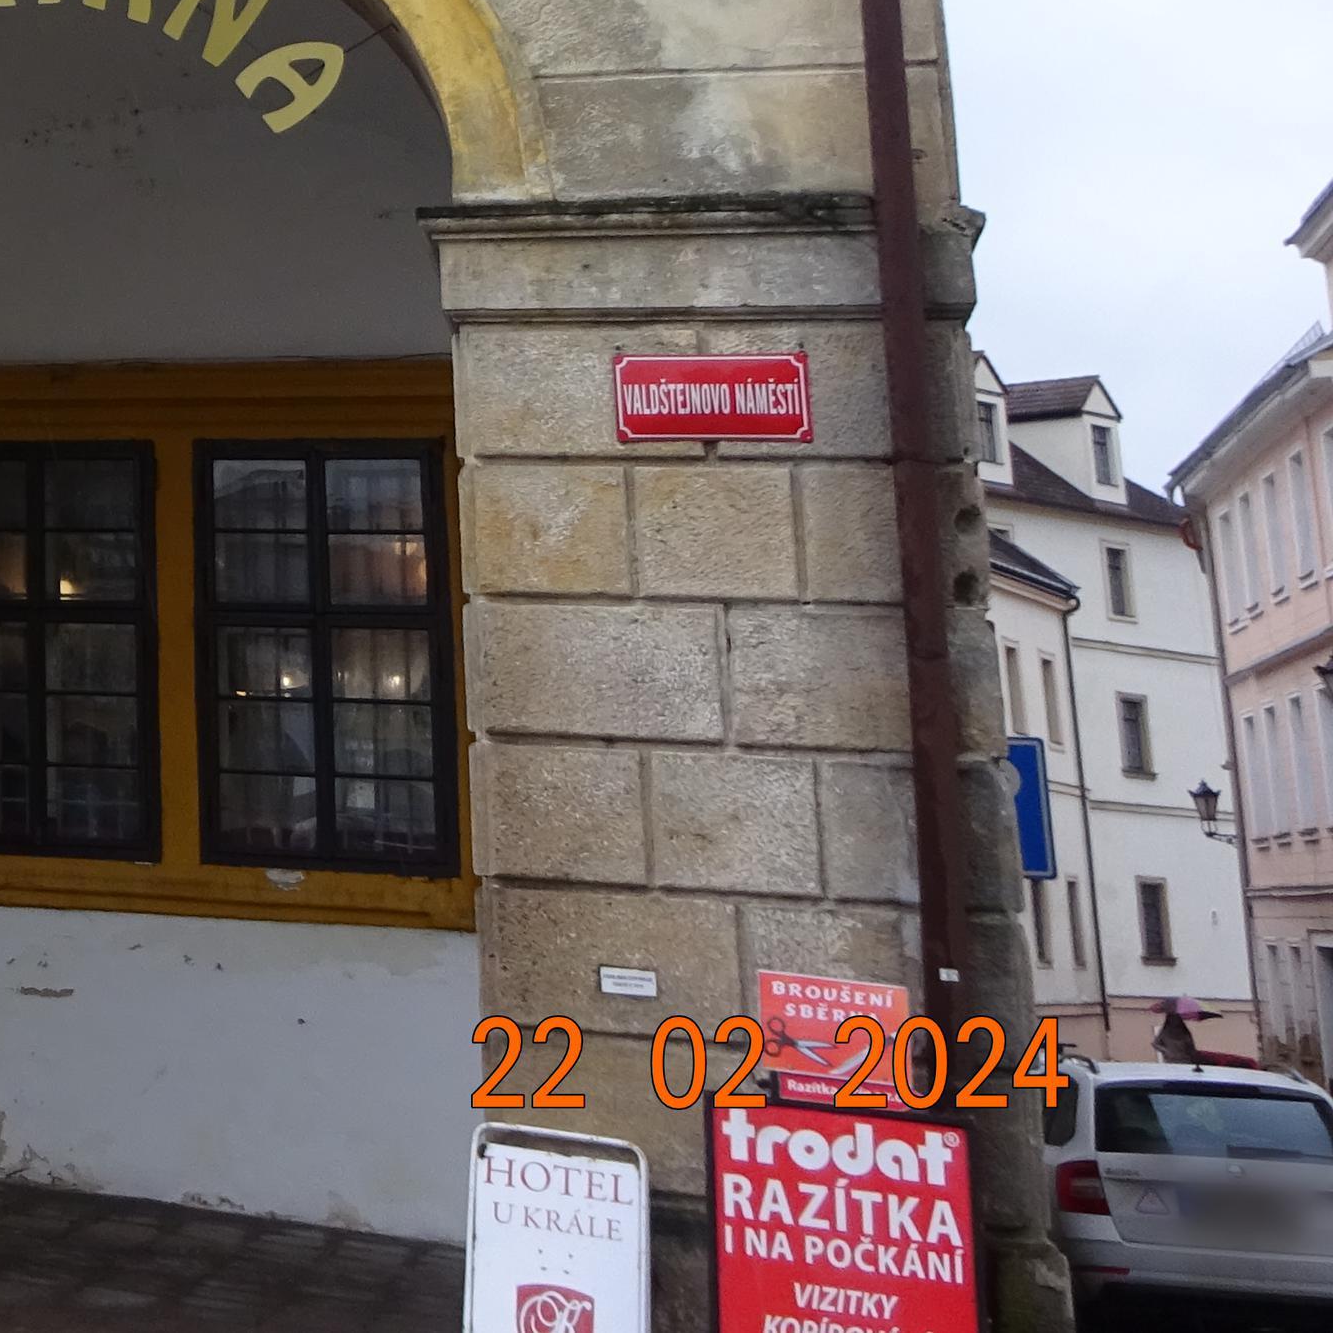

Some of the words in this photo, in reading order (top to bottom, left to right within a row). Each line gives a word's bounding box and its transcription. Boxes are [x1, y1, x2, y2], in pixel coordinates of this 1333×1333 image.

[623, 378, 731, 416] VALDŠTEJNOVO
[735, 378, 801, 416] NÁMĚSTÍ
[770, 980, 894, 1009] BROUŠENÍ
[484, 1154, 633, 1206] HOTEL
[493, 1200, 515, 1225] U
[523, 1204, 623, 1242] KRÁLE
[722, 1172, 964, 1248] RAZÍTKA
[724, 1223, 733, 1255] I
[745, 1226, 794, 1263] NA
[804, 1235, 965, 1285] POČKÁNÍ
[792, 1281, 900, 1320] VIZITKY
